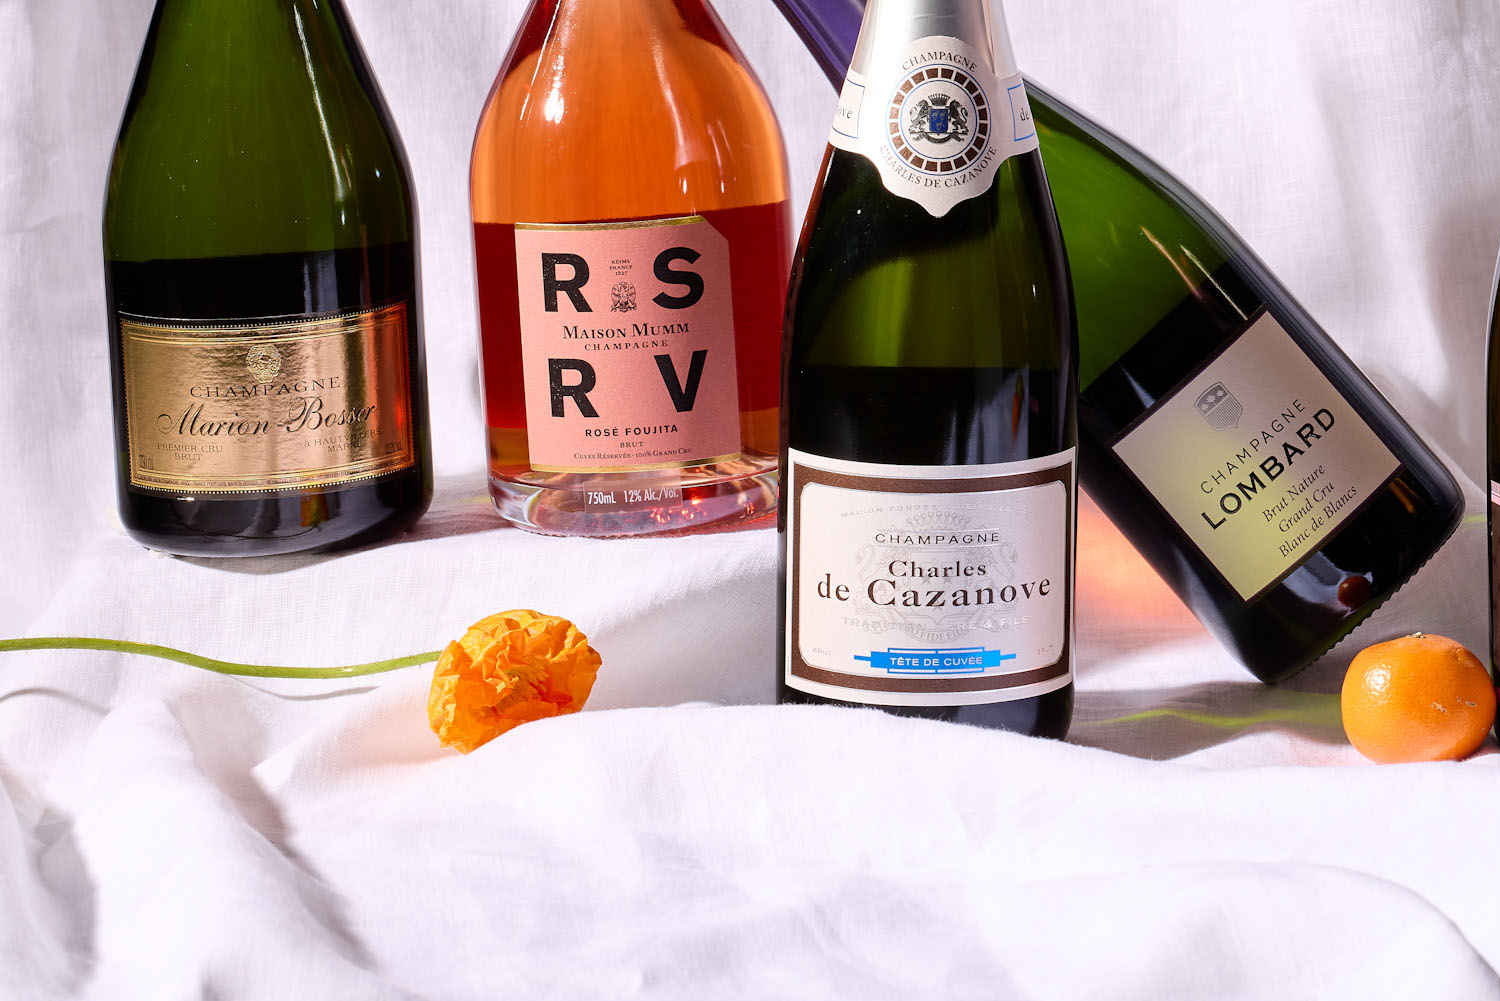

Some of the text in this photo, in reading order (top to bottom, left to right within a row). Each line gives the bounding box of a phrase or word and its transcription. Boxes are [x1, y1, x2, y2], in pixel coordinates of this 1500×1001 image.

[902, 51, 978, 73] CHAMPAGNE
[880, 145, 997, 188] CHARLES DE CAZANOVE
[541, 246, 705, 313] R S
[584, 339, 669, 351] CHAMPAGNE
[190, 376, 341, 398] CHAMPAGNE
[548, 349, 708, 418] R V
[585, 424, 679, 437] ROSÉ FOUJITA
[157, 442, 224, 453] PREMIER CRU
[619, 441, 645, 449] BRUT
[1200, 398, 1306, 494] CHAMPAGNE
[174, 453, 203, 461] BRUT
[1201, 408, 1335, 530] LOMBARD
[587, 490, 617, 505] 750mL
[623, 489, 642, 503] 12%
[1262, 465, 1326, 523] Brut Nature
[1278, 481, 1335, 533] Grand Cru
[1277, 485, 1358, 558] Blanc de Blancs
[874, 532, 1000, 545] CHAMPAGNE
[888, 560, 986, 578] Charles
[817, 573, 1051, 607] de Cazanove
[889, 655, 983, 667] TÊTE DE CUVÉE
